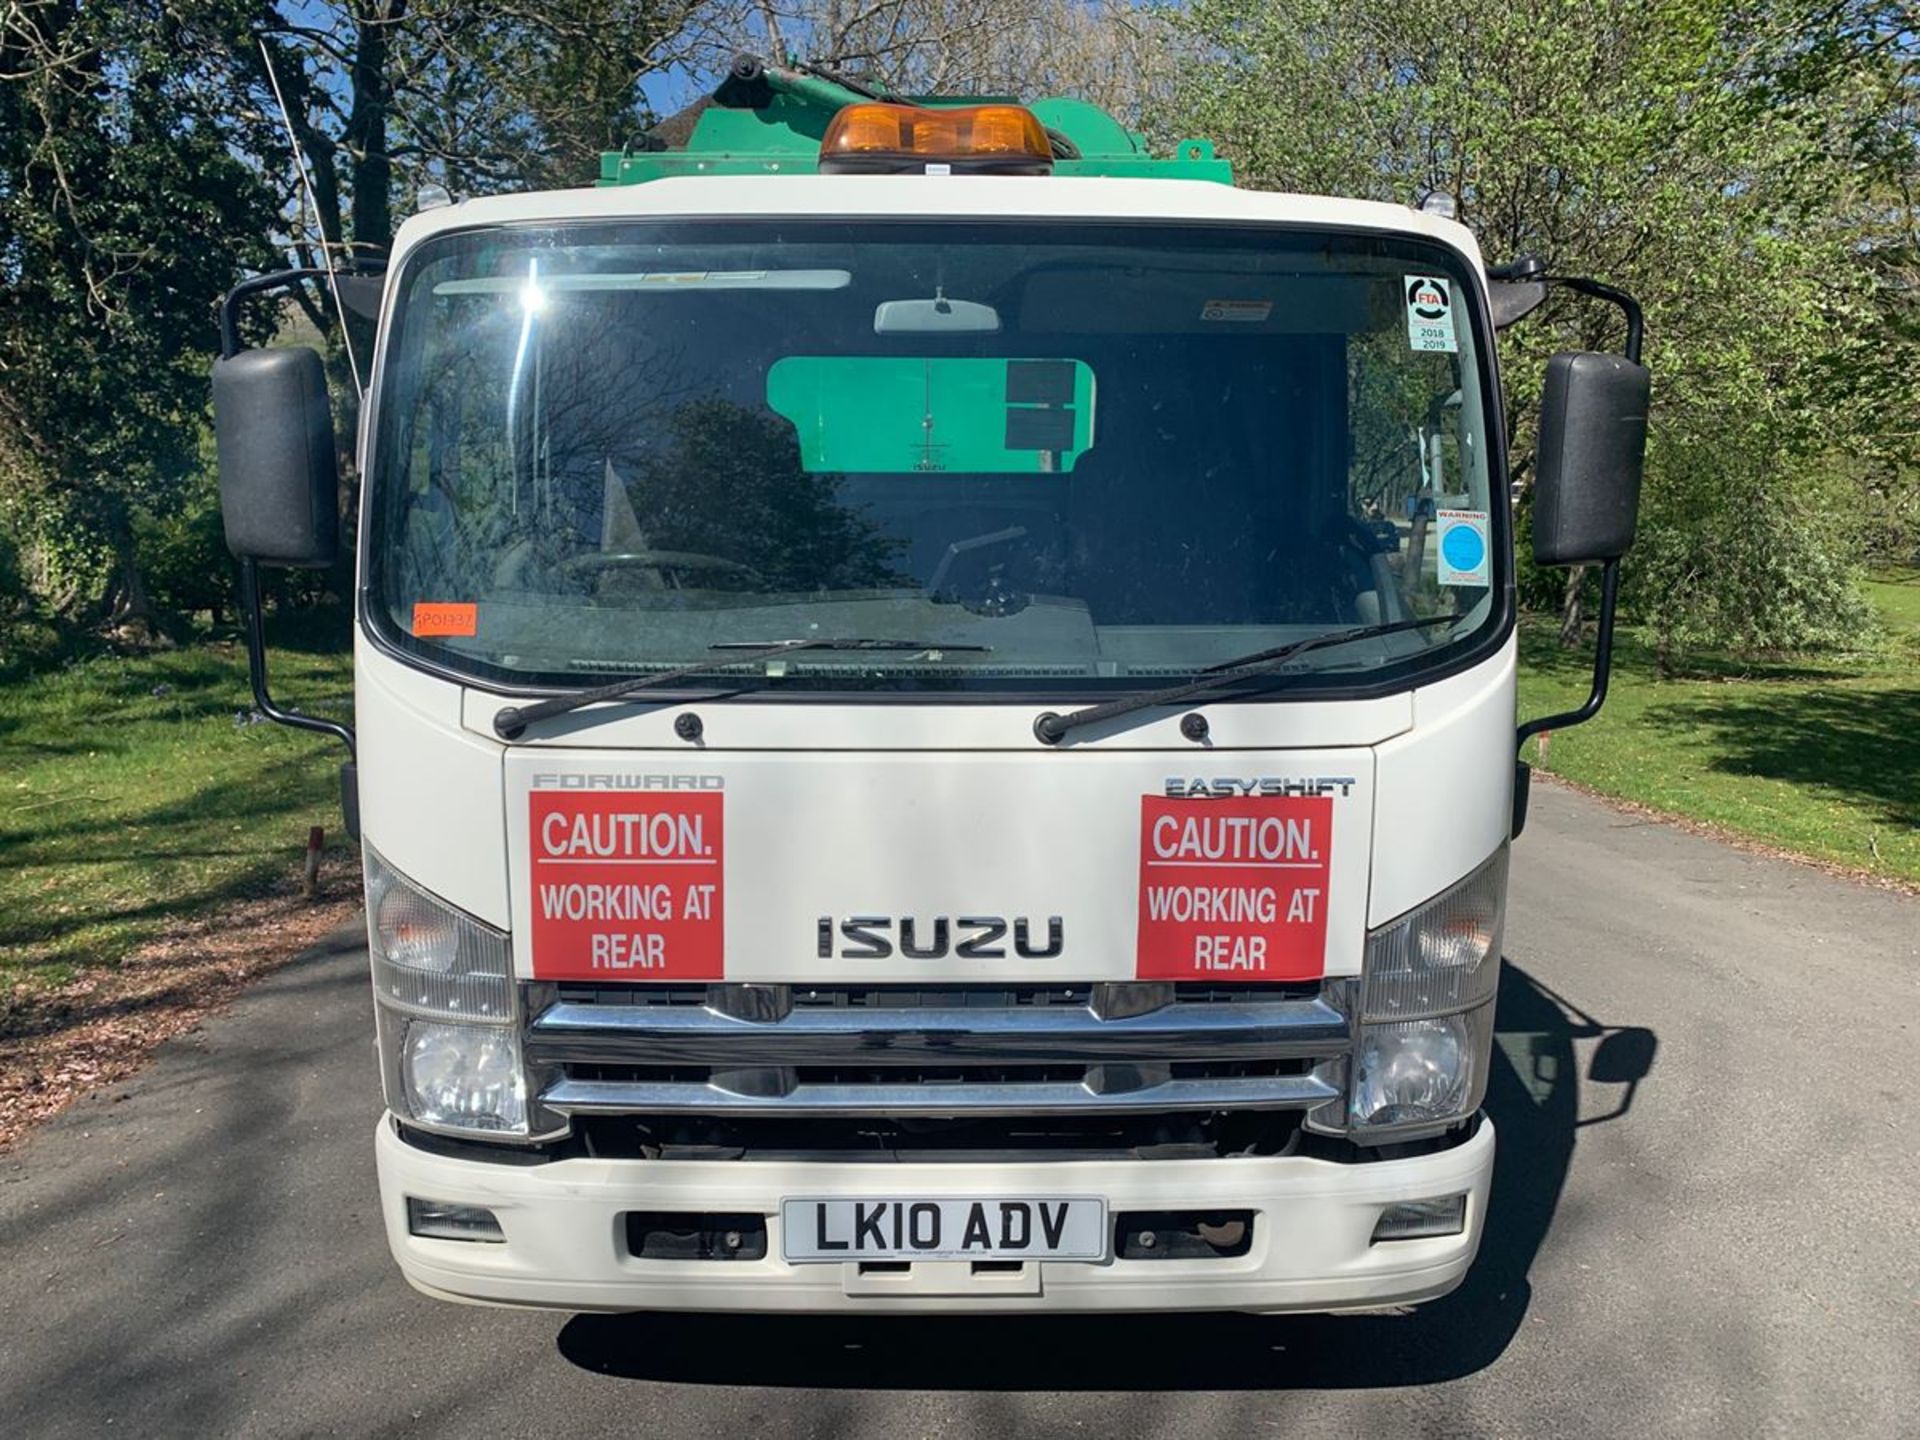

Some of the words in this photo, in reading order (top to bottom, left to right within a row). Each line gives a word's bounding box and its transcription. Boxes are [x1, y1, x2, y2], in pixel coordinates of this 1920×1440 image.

[1419, 293, 1440, 305] FTA
[1421, 328, 1445, 338] 2018
[1423, 341, 1446, 350] 2019
[1439, 511, 1486, 520] WARNING
[532, 774, 725, 789] FORWARD
[1165, 777, 1356, 797] EASYSHIFT
[542, 812, 712, 856] CAUTION.
[1153, 815, 1319, 859] CAUTION.
[540, 883, 671, 920] WORKING
[683, 884, 716, 919] AT
[1147, 886, 1276, 923] WORKING
[1286, 888, 1319, 922] AT
[591, 934, 665, 968] REAR
[818, 916, 1063, 959] ISUZU
[1194, 936, 1267, 970] REAR
[816, 1202, 941, 1250] LK10
[961, 1202, 1069, 1250] ADV
